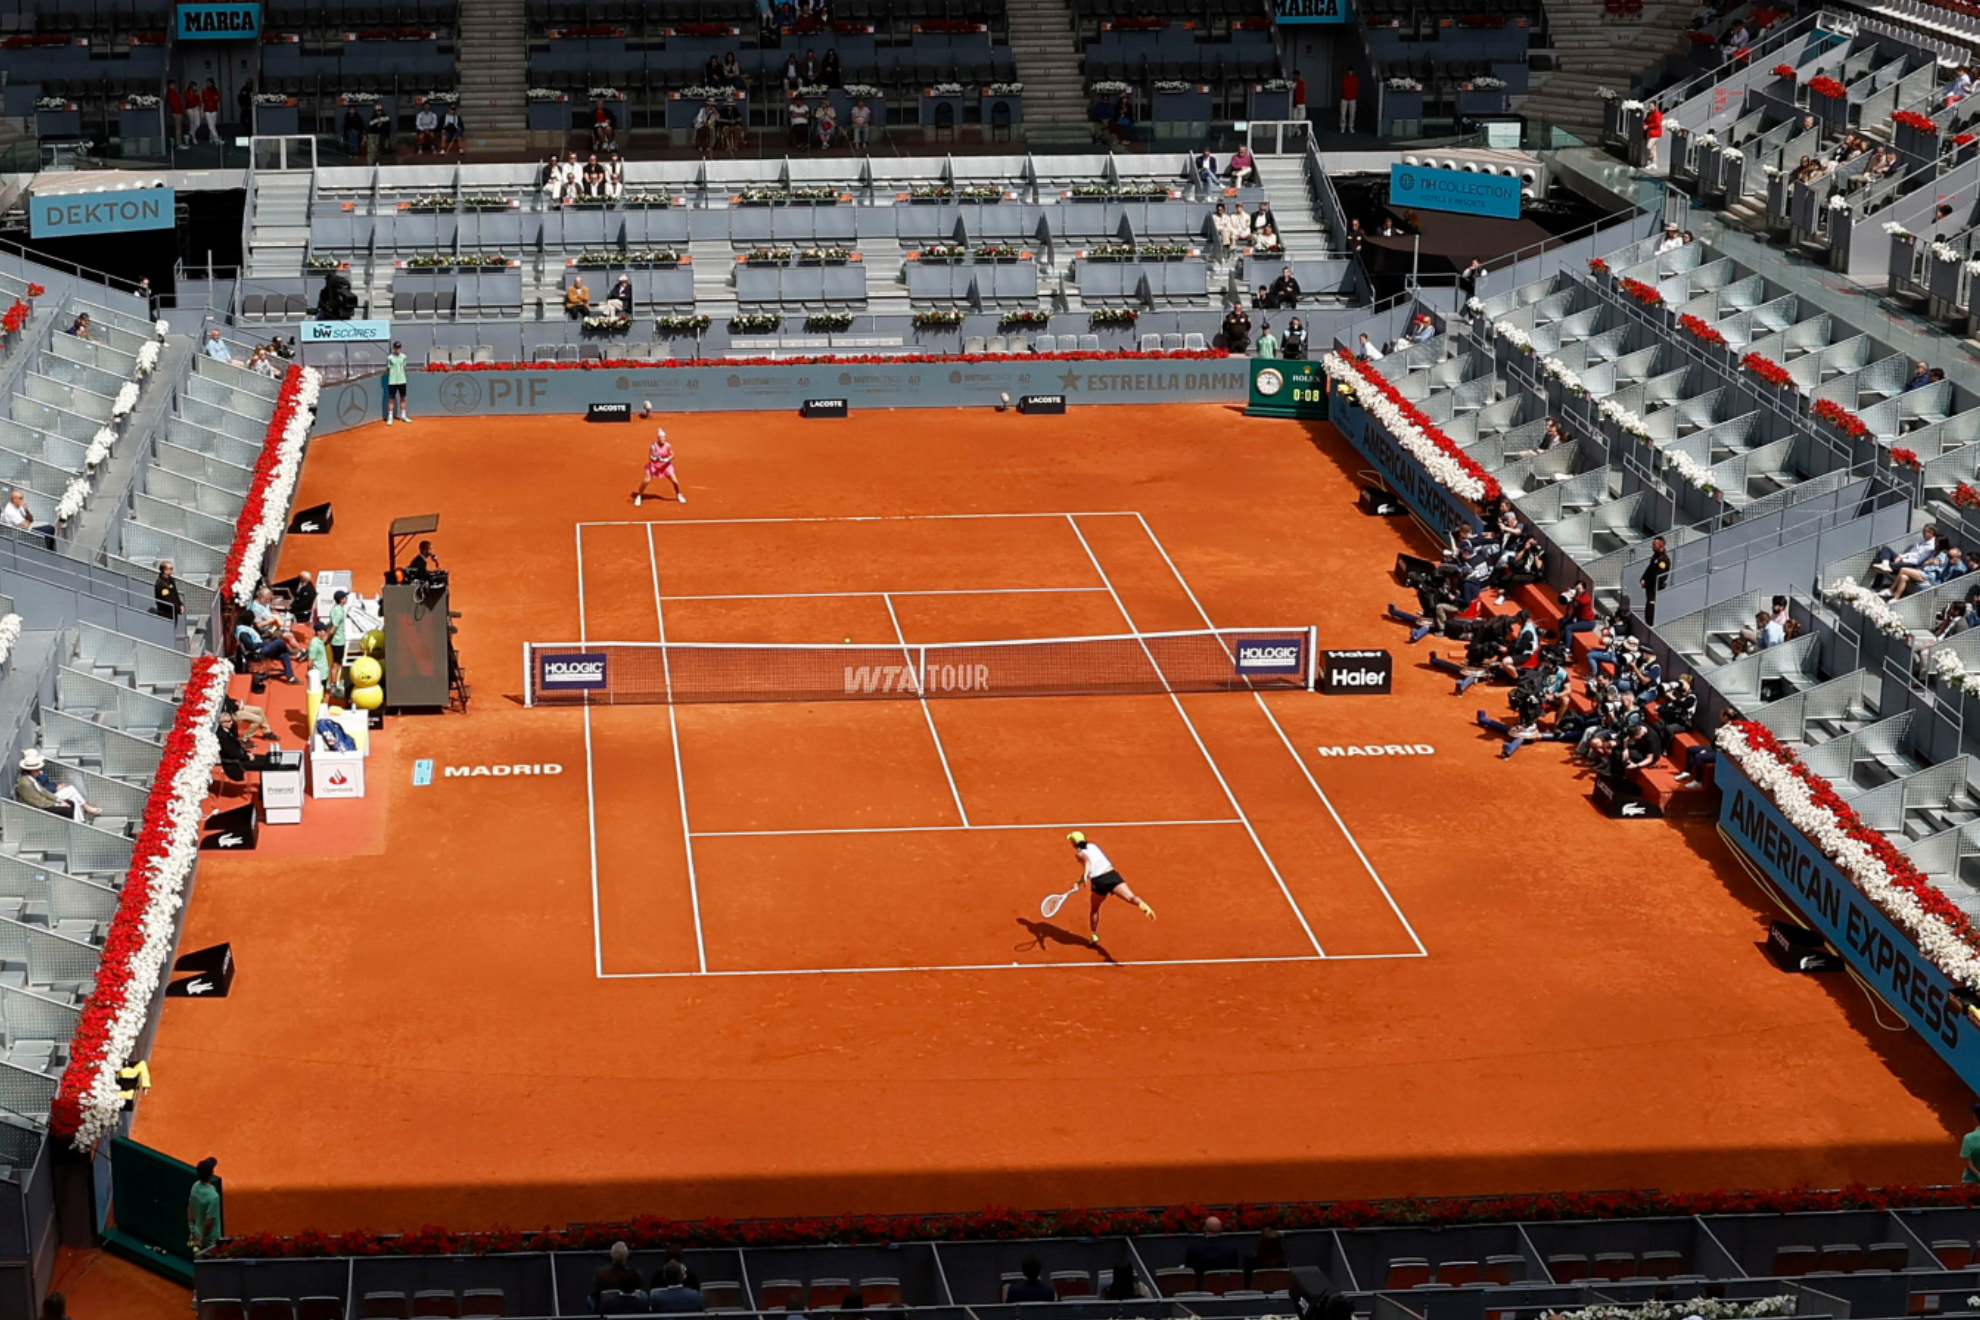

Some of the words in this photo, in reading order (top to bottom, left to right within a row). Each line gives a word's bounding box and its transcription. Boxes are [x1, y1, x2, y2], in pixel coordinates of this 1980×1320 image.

[1275, 0, 1339, 17] MARCA
[184, 11, 255, 32] MARCA
[1438, 180, 1513, 199] COLLECTION
[46, 199, 160, 227] DEKTON
[333, 328, 378, 338] SCORES
[1087, 373, 1183, 391] ESTRELLA
[1185, 372, 1245, 390] DAMM
[1292, 374, 1320, 382] ROLEX
[489, 378, 549, 407] PIF
[1293, 388, 1319, 402] 0:08
[809, 400, 843, 408] LACOSTE
[1028, 396, 1062, 404] LACOSTE
[593, 404, 627, 412] LACOSTE
[1362, 423, 1415, 496] AMERICAN
[1418, 475, 1471, 530] EXPRES
[1240, 647, 1297, 659] HOLOGIC
[1327, 650, 1382, 658] Haier
[544, 662, 603, 674] HOLOGIC
[844, 665, 917, 694] WTA
[926, 664, 989, 691] TOUR
[1332, 668, 1386, 686] Haier
[1317, 744, 1435, 757] MADRID
[444, 763, 563, 777] MADRID
[1729, 788, 1841, 930] AMERICAN
[1846, 901, 1959, 1050] EXPRESS
